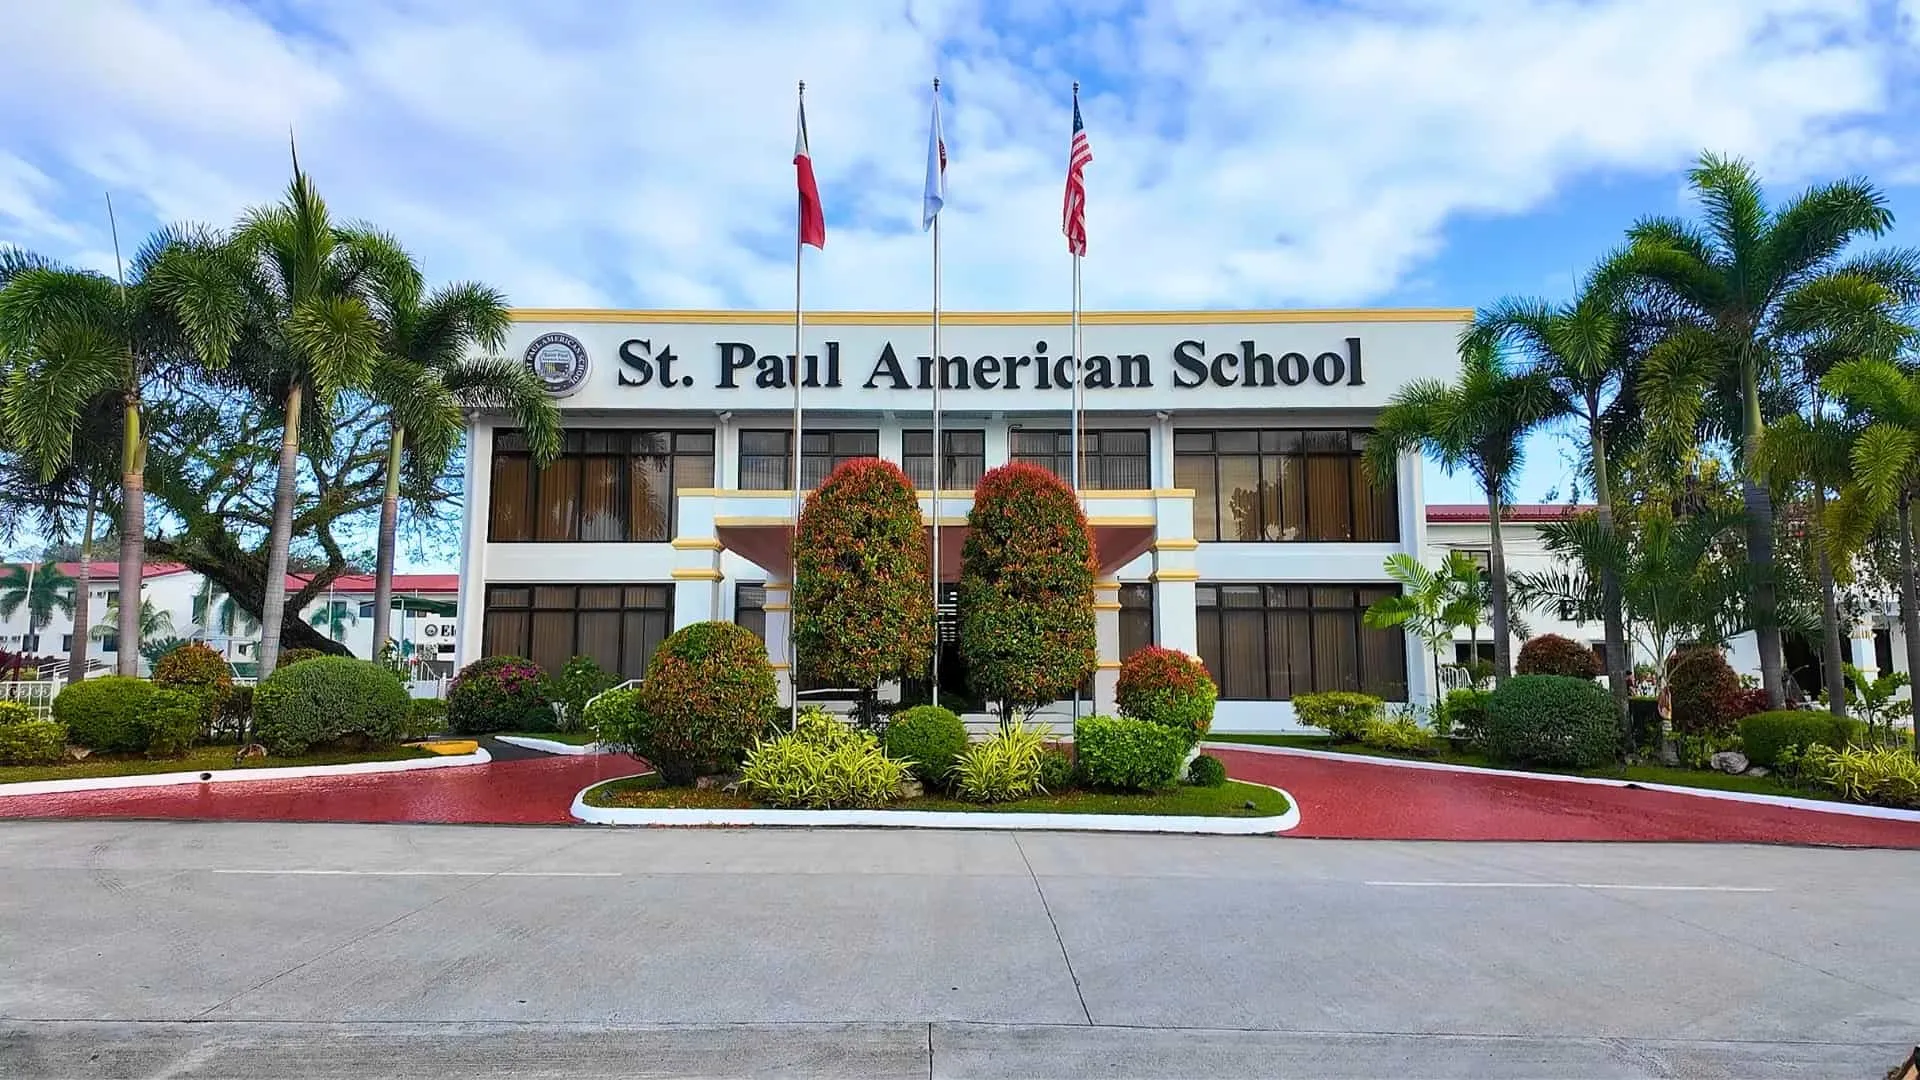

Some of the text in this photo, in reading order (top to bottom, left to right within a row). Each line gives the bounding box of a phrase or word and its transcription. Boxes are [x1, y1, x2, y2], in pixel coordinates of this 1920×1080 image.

[541, 334, 582, 354] AMERICAN
[618, 337, 1366, 390] St. Paul American School
[441, 624, 457, 637] El
